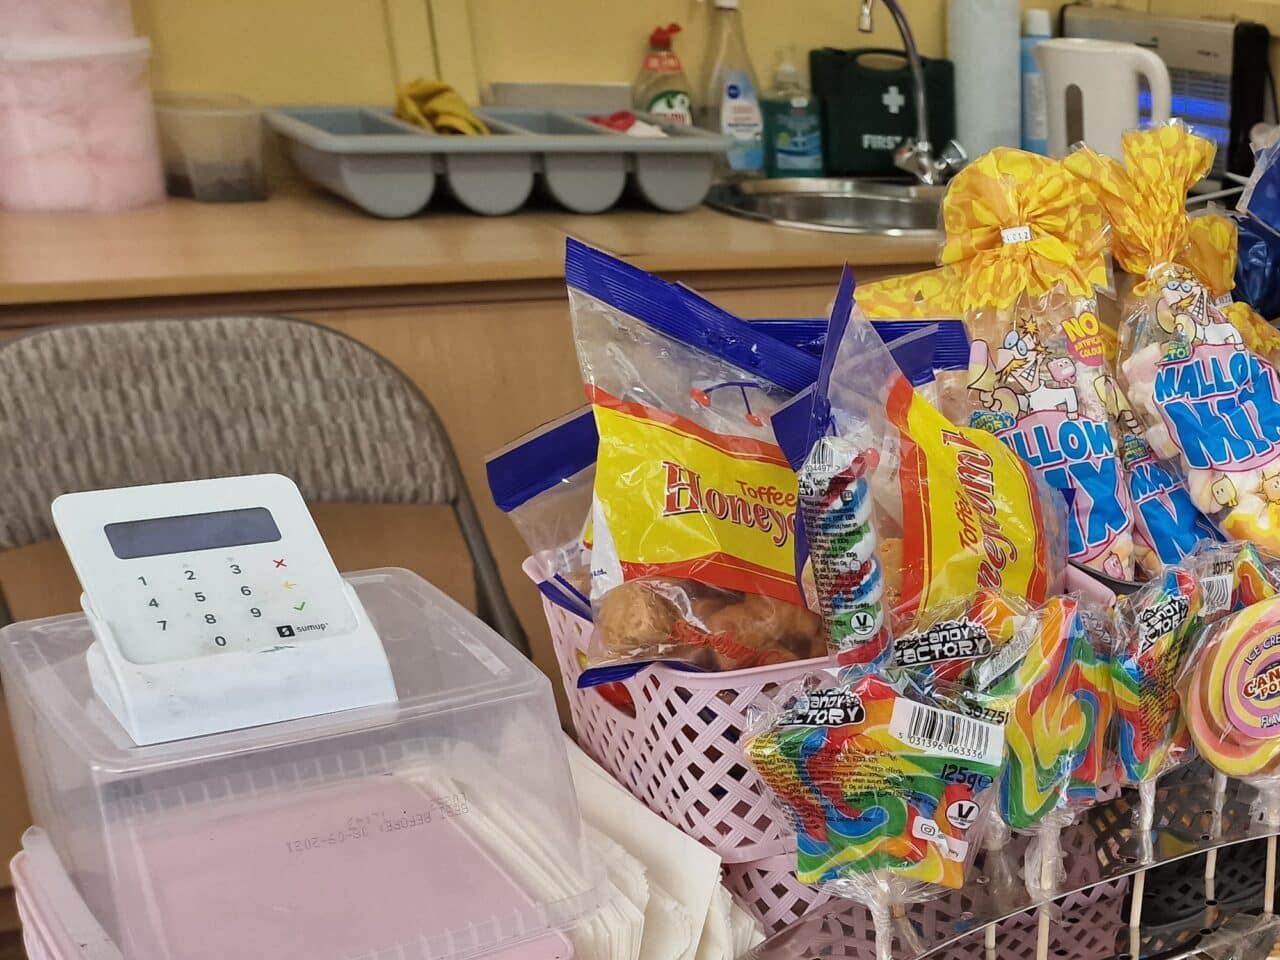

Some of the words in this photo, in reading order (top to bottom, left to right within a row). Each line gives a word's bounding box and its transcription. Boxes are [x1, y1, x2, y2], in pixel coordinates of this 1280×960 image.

[862, 134, 901, 149] FIRST
[1060, 311, 1100, 342] NO
[736, 480, 796, 508] Toffee
[1044, 457, 1129, 556] IX
[138, 576, 147, 586] 1
[185, 569, 196, 581] 2
[230, 564, 241, 575] 3
[149, 597, 159, 609] 4
[195, 591, 206, 603] 5
[241, 585, 252, 597] 6
[157, 619, 168, 631] 7
[205, 613, 216, 625] 8
[250, 607, 262, 619] 9
[297, 622, 329, 635] sumup
[215, 635, 227, 647] 0
[1244, 644, 1262, 665] ICE
[947, 745, 984, 760] 063336
